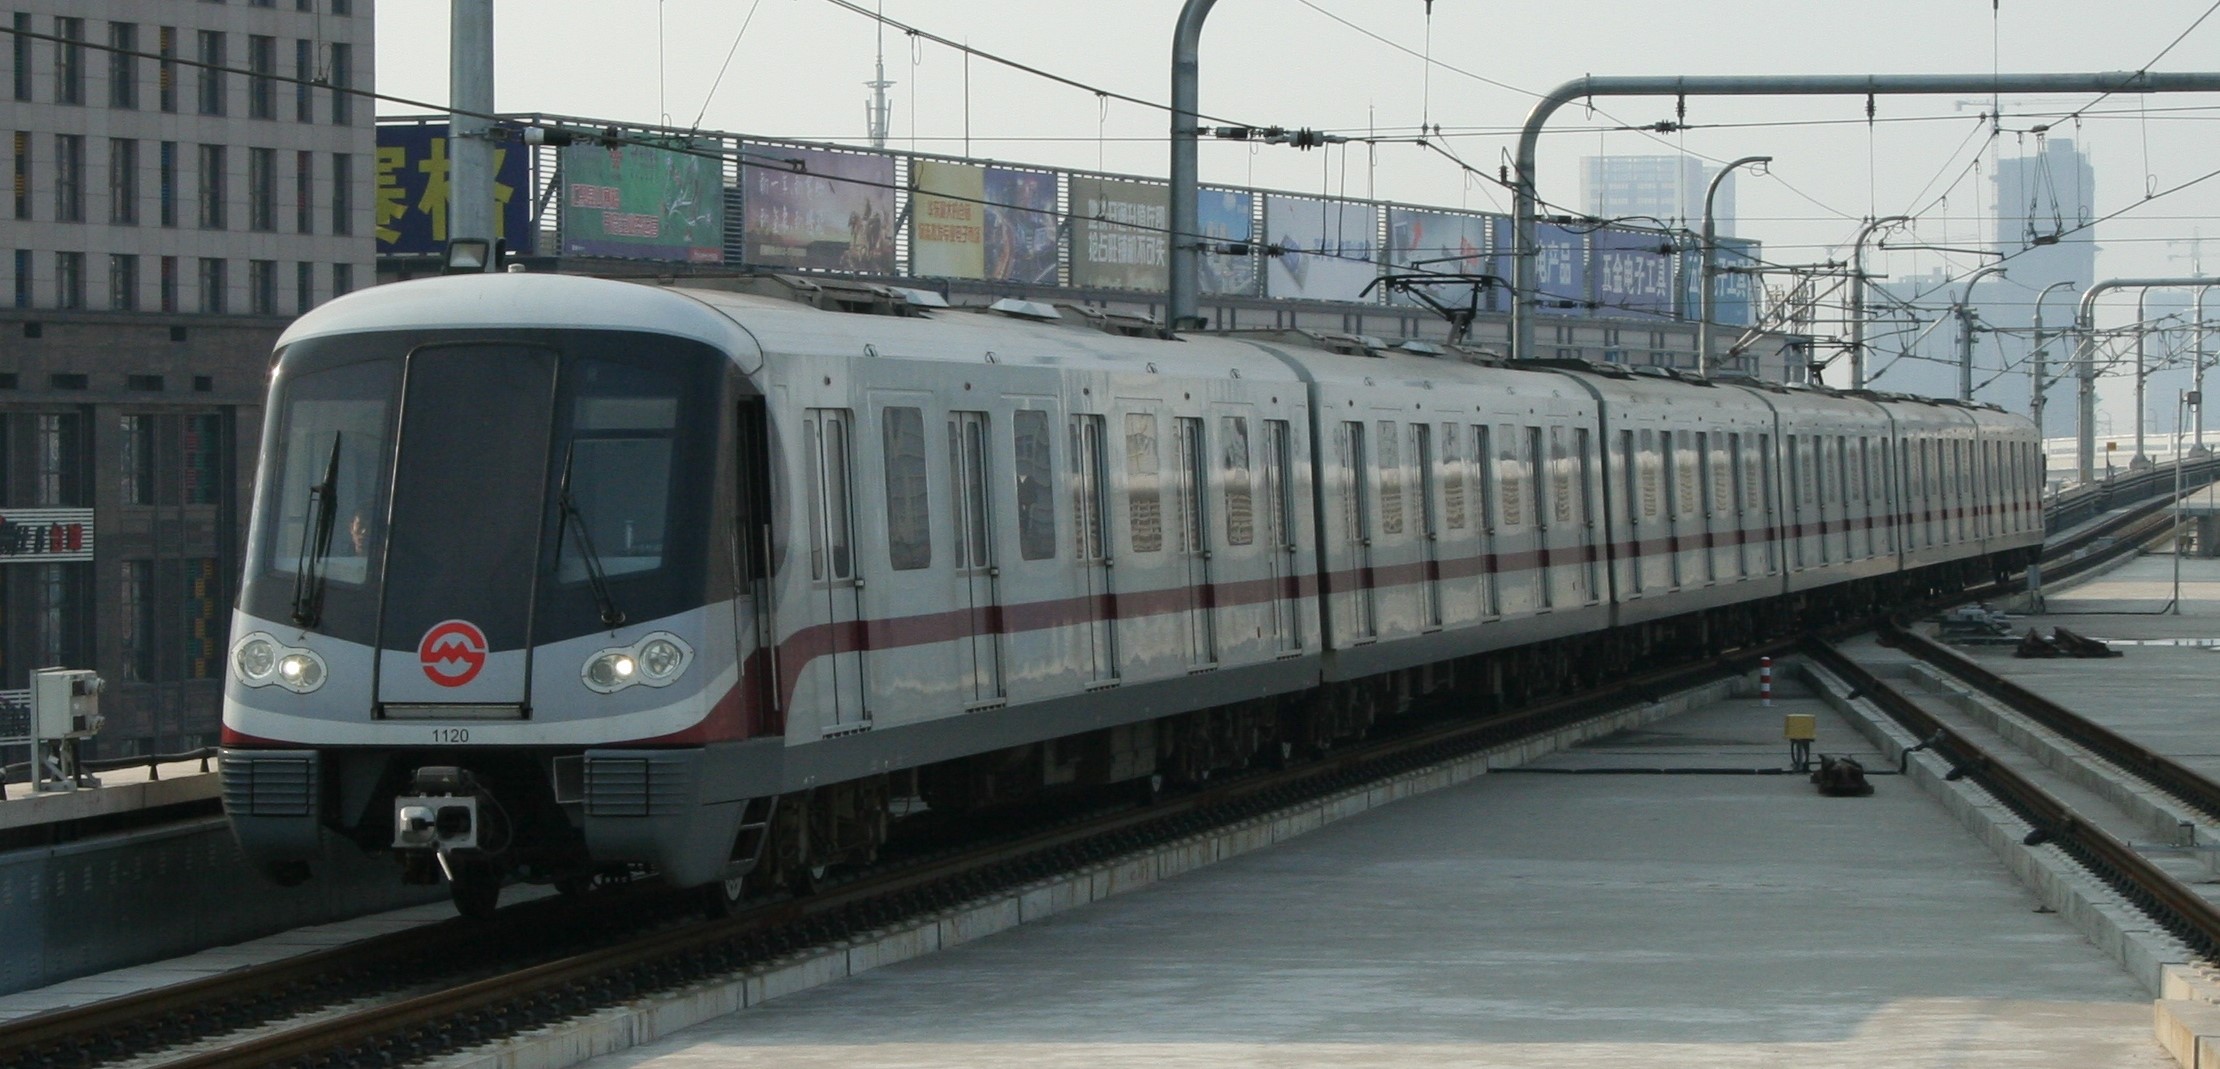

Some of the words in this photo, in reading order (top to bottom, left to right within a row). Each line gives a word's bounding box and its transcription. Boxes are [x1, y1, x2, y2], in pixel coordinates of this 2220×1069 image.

[1602, 254, 1667, 296] 五金电子工具
[432, 728, 469, 743] 1120
